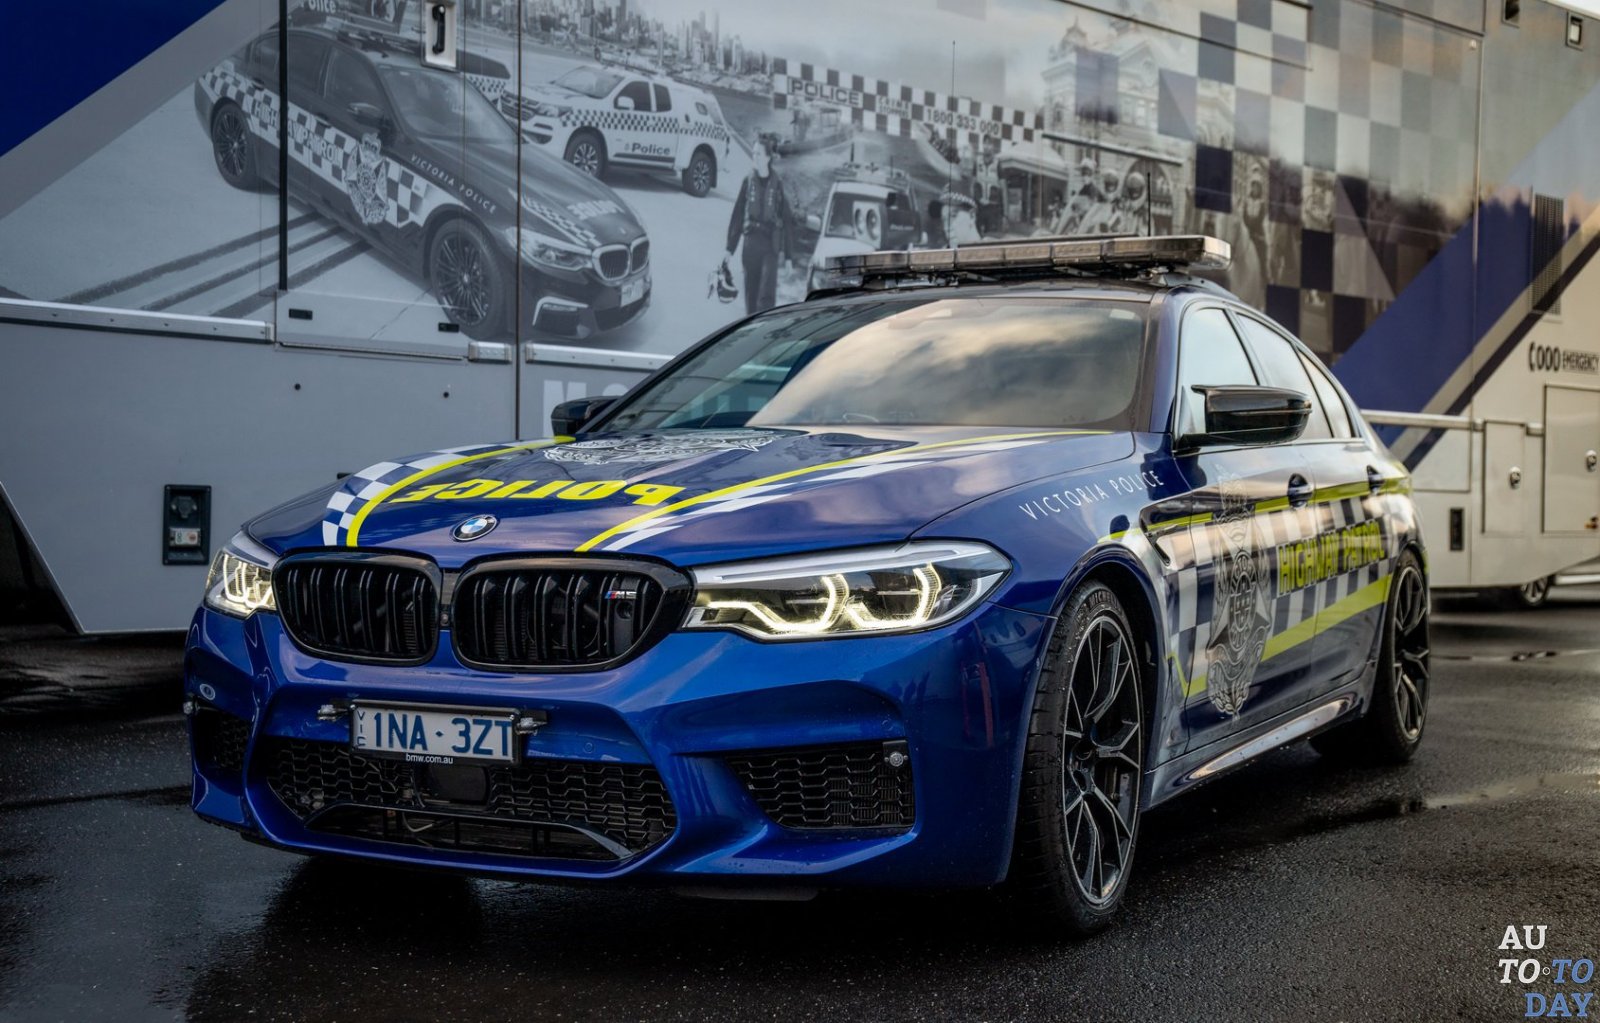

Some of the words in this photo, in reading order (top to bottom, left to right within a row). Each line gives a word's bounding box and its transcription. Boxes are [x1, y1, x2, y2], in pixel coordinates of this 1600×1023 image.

[791, 80, 860, 106] POLICE
[251, 99, 297, 140] HIGHAY
[926, 108, 954, 126] 1800
[980, 120, 1000, 135] 000
[631, 143, 671, 156] Police
[411, 153, 455, 187] VICTORIA
[459, 184, 497, 213] POLICE
[1018, 483, 1110, 520] VICTORIA
[1109, 470, 1164, 495] POLICE
[1279, 532, 1340, 596] HIGHWAY
[357, 711, 366, 747] VIC
[374, 712, 428, 751] 1NA
[451, 717, 512, 757] 3ZT
[405, 754, 454, 764] bmw.com.au
